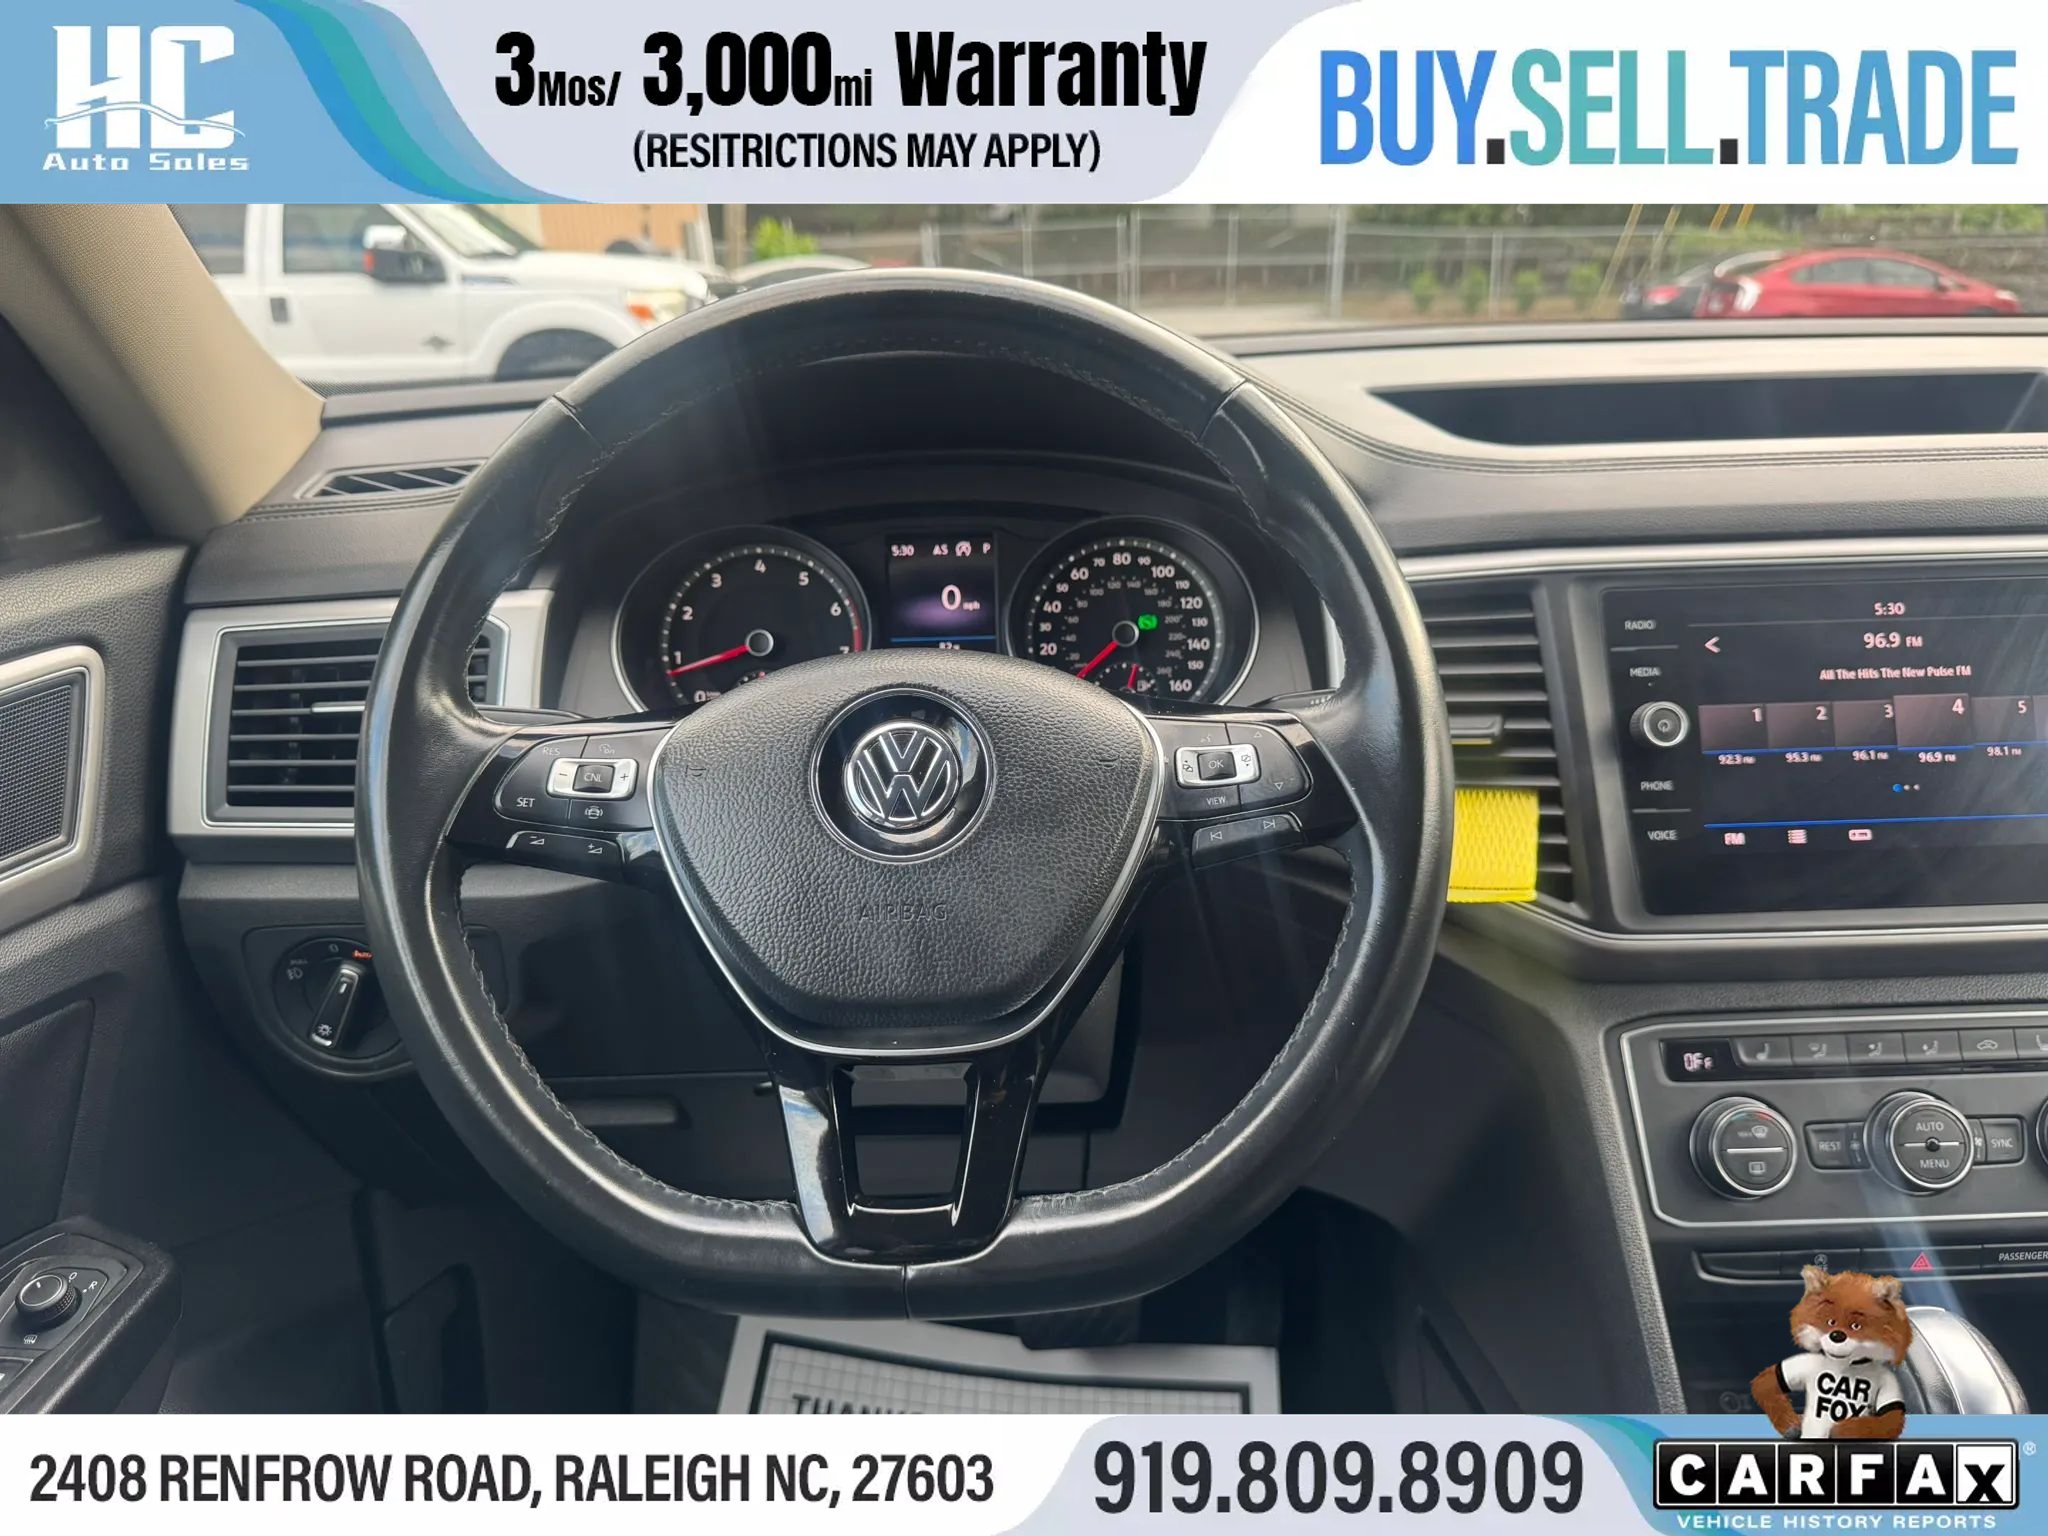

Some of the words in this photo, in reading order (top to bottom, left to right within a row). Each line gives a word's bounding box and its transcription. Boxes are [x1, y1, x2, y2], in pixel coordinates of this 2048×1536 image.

[891, 544, 915, 556] 5:30
[982, 542, 992, 554] P
[1092, 557, 1106, 568] 70
[1112, 552, 1132, 566] 80
[1137, 556, 1152, 566] 90
[754, 560, 766, 574] 4
[1151, 565, 1176, 578] 100
[799, 571, 809, 586] 5
[1070, 567, 1089, 580] 60
[711, 573, 722, 588] 3
[1175, 580, 1190, 590] 110
[1056, 582, 1069, 593] 50
[941, 584, 962, 611] 0
[1180, 596, 1204, 610] 120
[830, 602, 842, 616] 6
[1043, 600, 1062, 613] 40
[1874, 602, 1906, 616] 5:30
[682, 606, 693, 620] 2
[1040, 622, 1052, 632] 30
[1192, 617, 1208, 628] 130
[1624, 620, 1656, 630] RADIO
[1187, 638, 1210, 651] 140
[1863, 632, 1900, 649] 96.9
[1906, 636, 1923, 648] FM
[1040, 642, 1058, 656] 20
[674, 651, 682, 664] 1
[1187, 660, 1204, 670] 150
[1629, 666, 1662, 678] MEDIA
[1819, 669, 1834, 680] All
[1836, 668, 1856, 680] The
[1858, 668, 1880, 680] Hits
[1880, 668, 1901, 678] The
[1902, 667, 1926, 678] New
[1926, 666, 1956, 678] Pulse
[1956, 665, 1972, 676] FM
[1169, 678, 1192, 692] 160
[1815, 705, 1828, 720] 2
[1884, 704, 1894, 718] 3
[1952, 698, 1965, 715] 4
[2018, 700, 2027, 714] 5
[1752, 708, 1763, 722] 1
[542, 746, 560, 756] RES
[1852, 750, 1876, 761] 96.1
[1918, 751, 1942, 763] 96.9
[1986, 746, 2009, 756] 98.1
[1718, 754, 1742, 765] 92.3
[1784, 752, 1809, 763] 95.3
[1208, 760, 1224, 770] OK
[583, 772, 602, 782] CNL
[1640, 780, 1674, 791] PHONE
[516, 797, 536, 808] SET
[1206, 796, 1226, 806] VIEW
[1647, 830, 1679, 841] VOICE
[860, 904, 948, 922] AIRBAG
[1915, 1120, 1945, 1133] AUTO
[1818, 1140, 1842, 1152] REST
[1990, 1137, 2015, 1149] SYNC
[1920, 1158, 1950, 1169] MENU
[1998, 1250, 2048, 1262] PASSENGER
[88, 1280, 98, 1290] R
